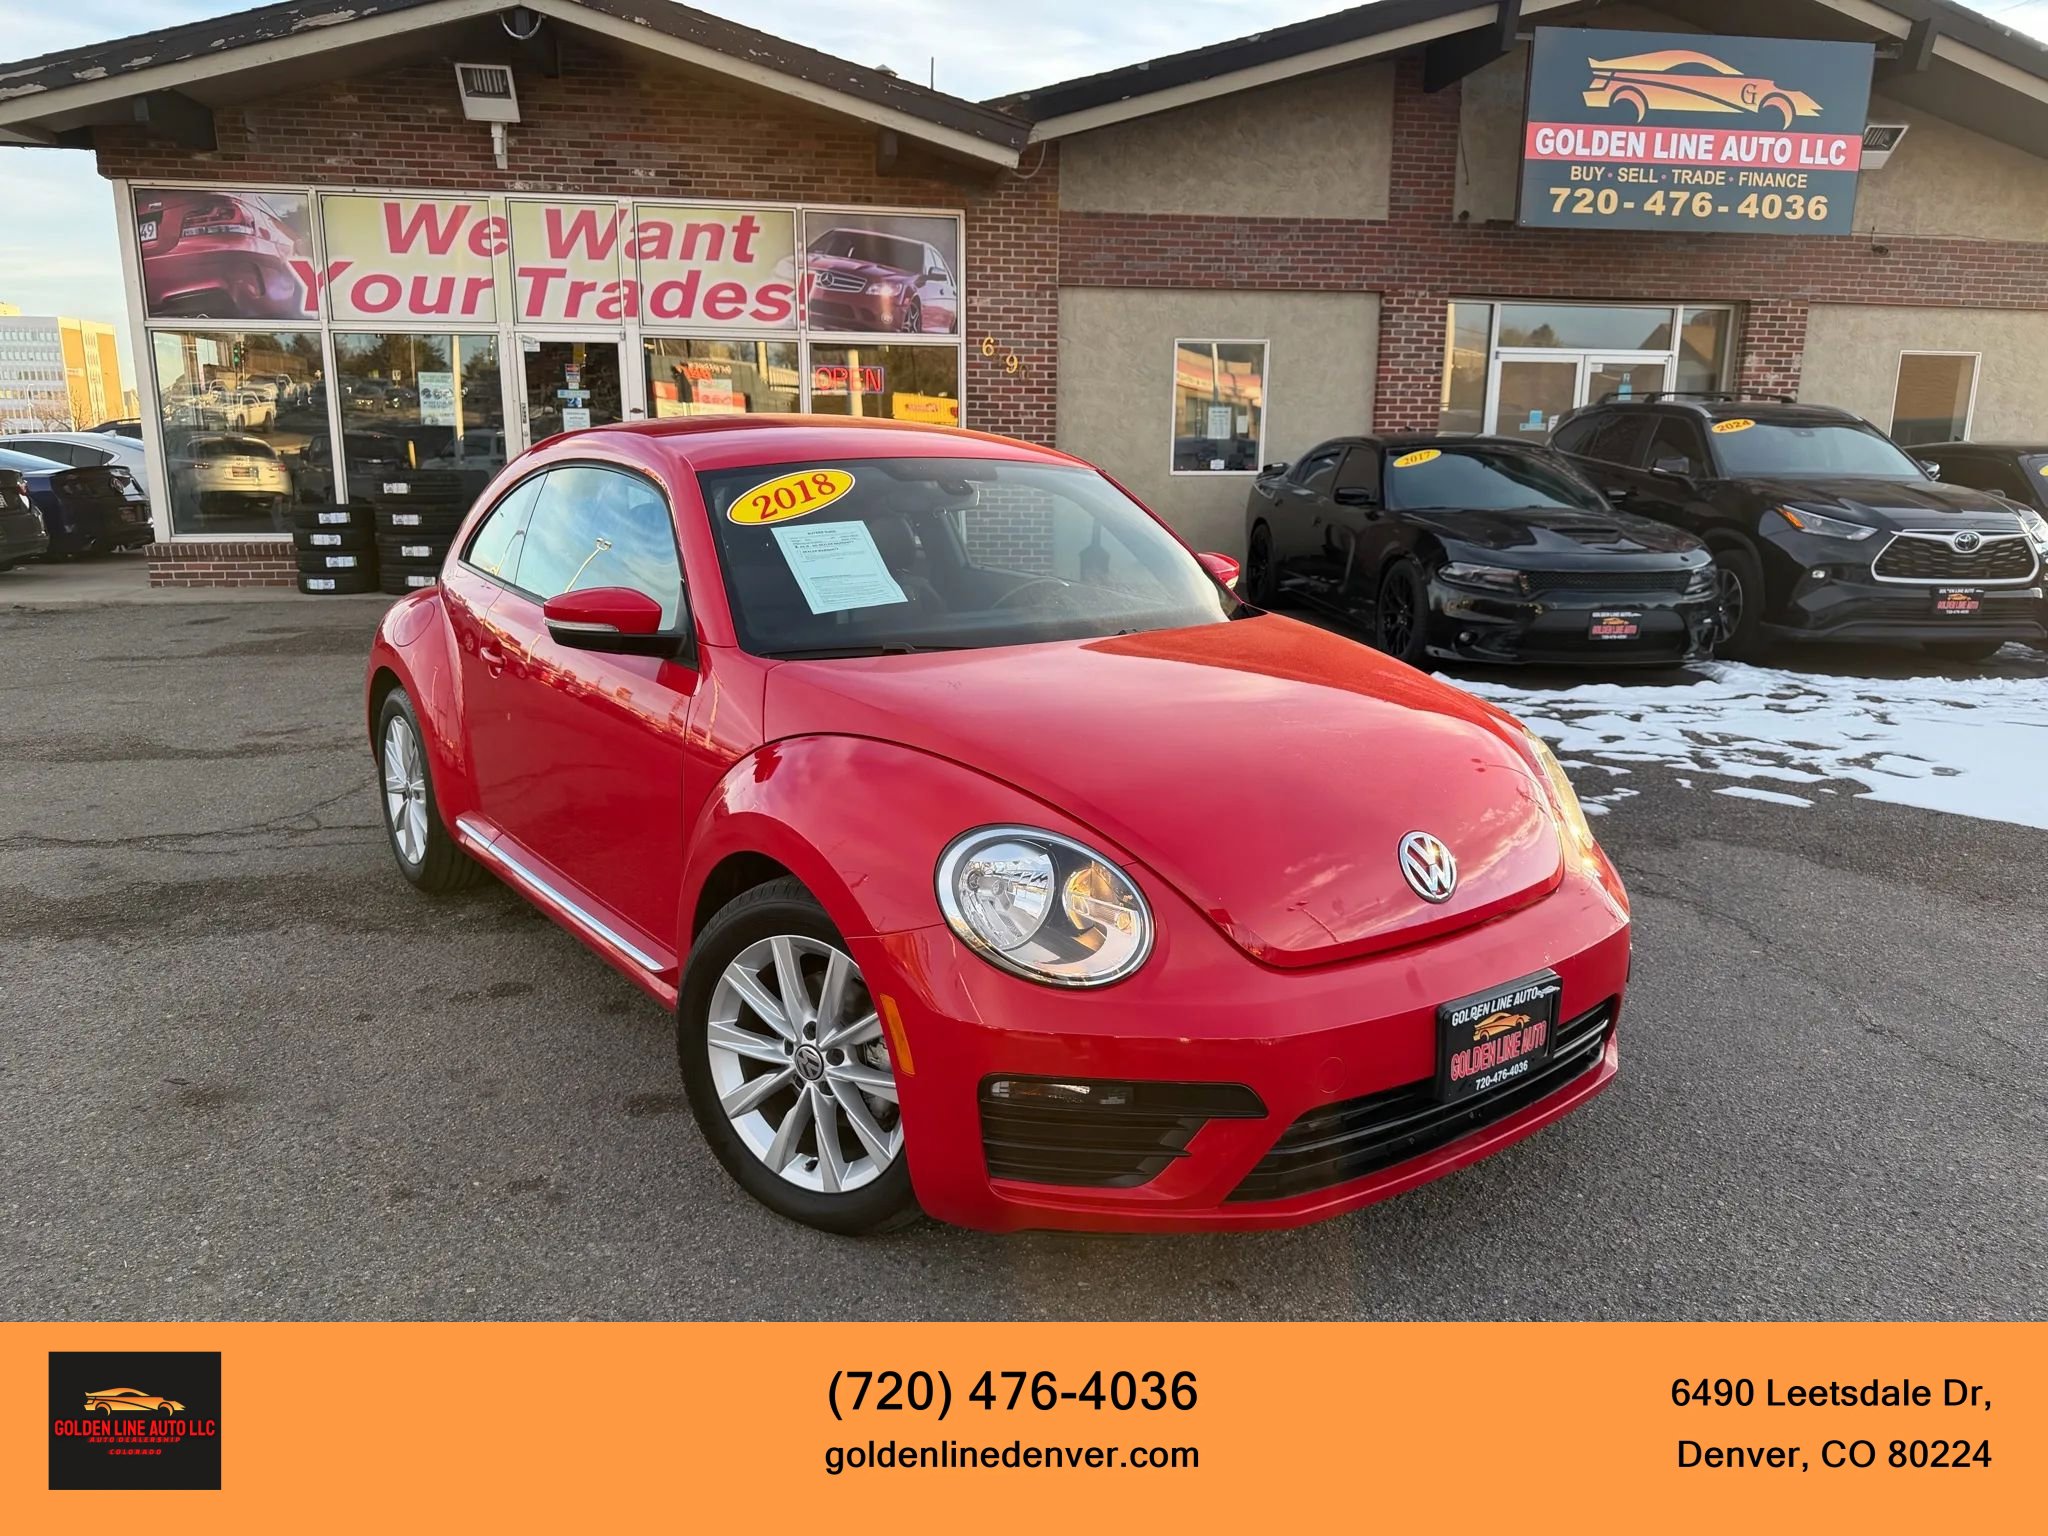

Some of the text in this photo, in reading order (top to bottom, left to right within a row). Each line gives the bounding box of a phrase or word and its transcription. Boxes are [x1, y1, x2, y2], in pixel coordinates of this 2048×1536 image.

[1535, 127, 1847, 166] GOLDEN LINE AUTO LLC
[1570, 165, 1808, 188] BUY SELL TRADE FINANCE
[384, 202, 760, 263] We Want
[288, 260, 495, 315] Your
[815, 367, 882, 392] OPEN
[1716, 420, 1751, 432] 2024
[1403, 451, 1431, 465] 2017
[752, 473, 836, 520] 2018
[1451, 986, 1539, 1027] GOLDEN LINE AUTO
[1450, 1020, 1547, 1081] GOLDEN LINE AUTO
[1475, 1060, 1529, 1090] 720-476-4036
